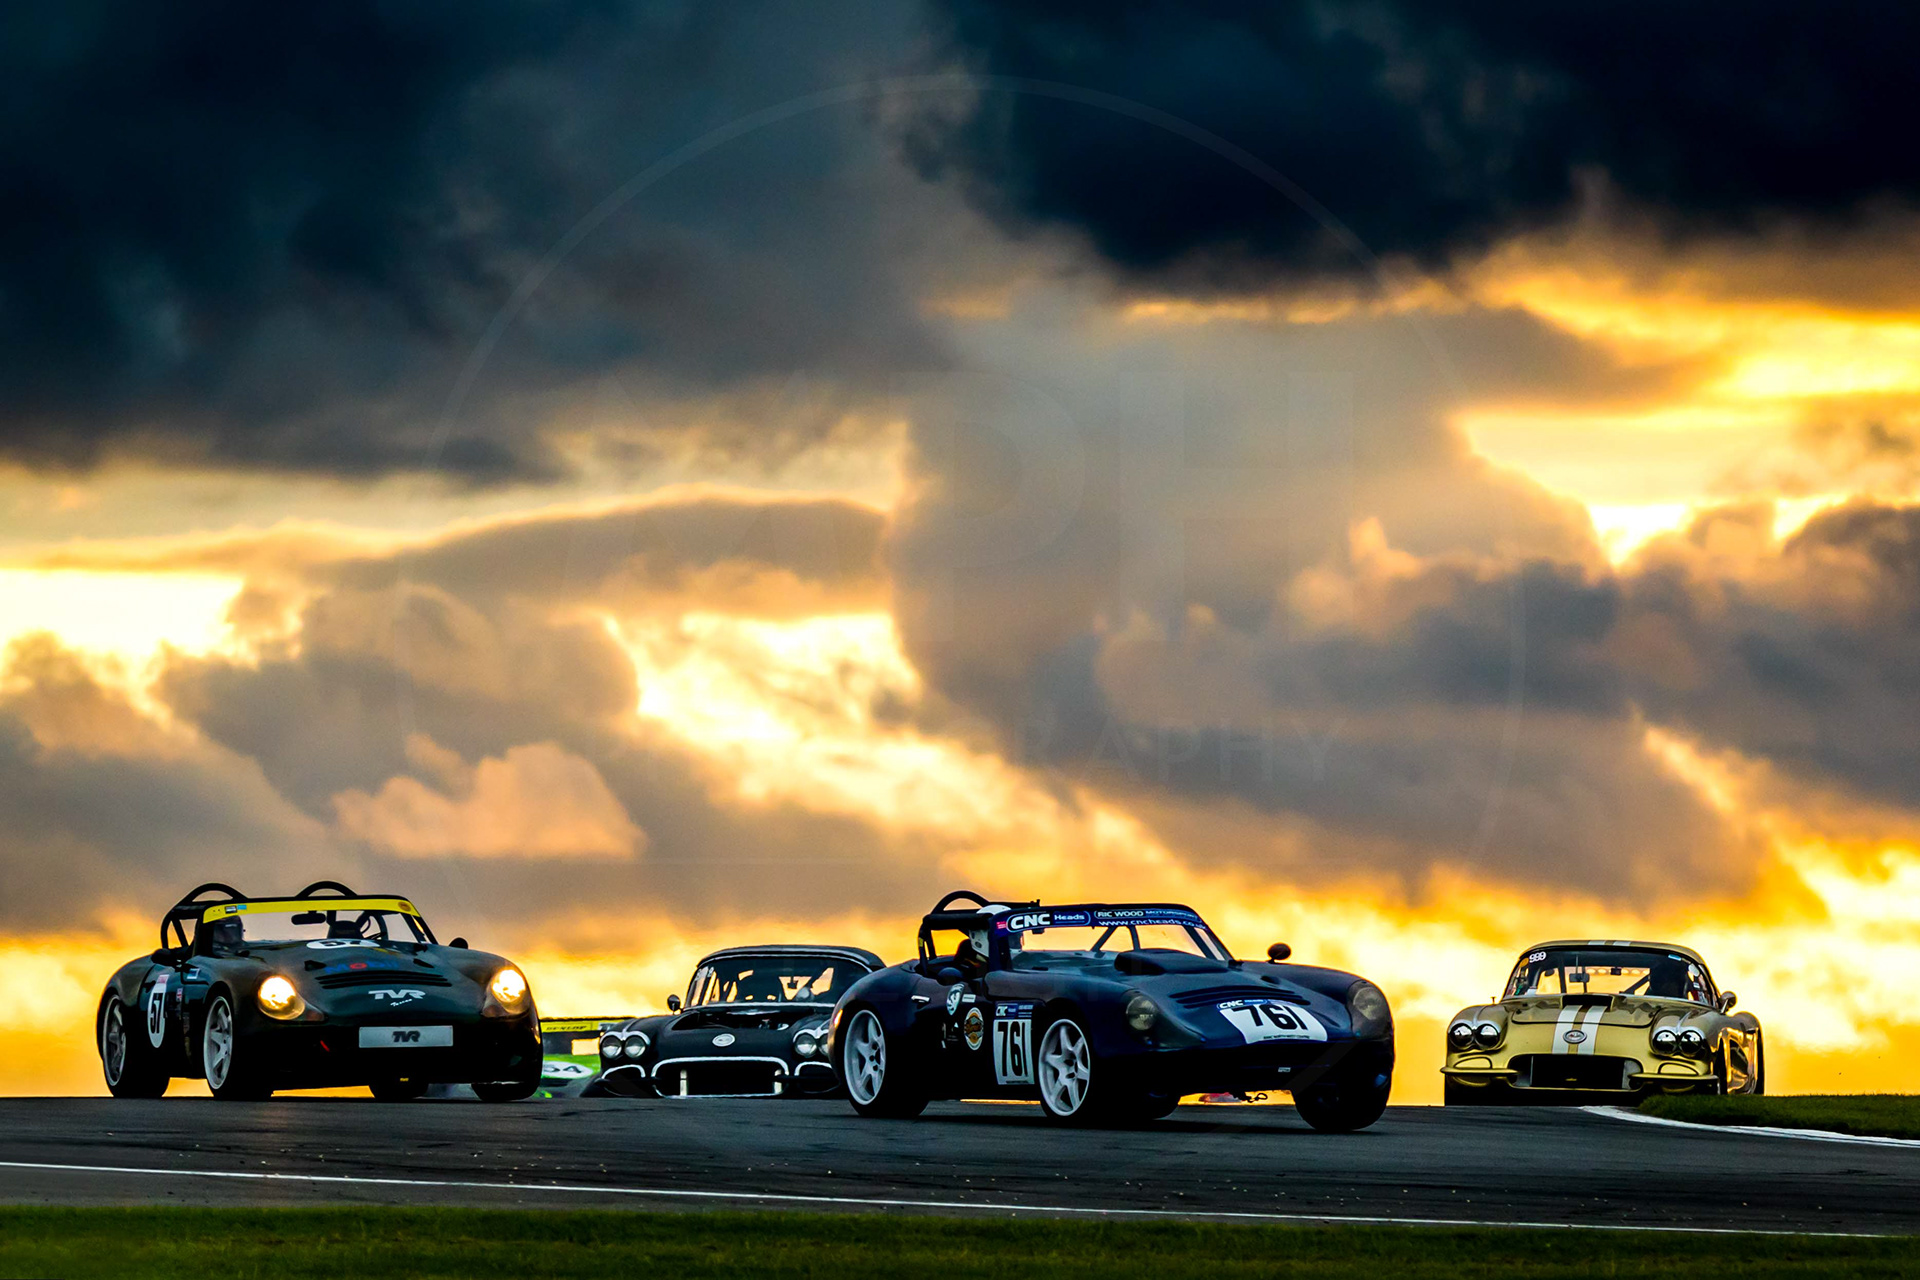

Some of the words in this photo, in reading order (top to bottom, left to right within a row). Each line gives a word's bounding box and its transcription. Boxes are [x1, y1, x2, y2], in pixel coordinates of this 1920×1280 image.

[1010, 914, 1051, 930] CNC
[1054, 913, 1085, 921] Heads
[1114, 910, 1144, 918] WOOD
[368, 989, 426, 1000] TVR
[1219, 999, 1244, 1009] CNC
[150, 992, 164, 1034] 57
[1232, 1003, 1308, 1031] 761
[392, 1030, 421, 1043] TVR
[998, 1021, 1028, 1076] 761
